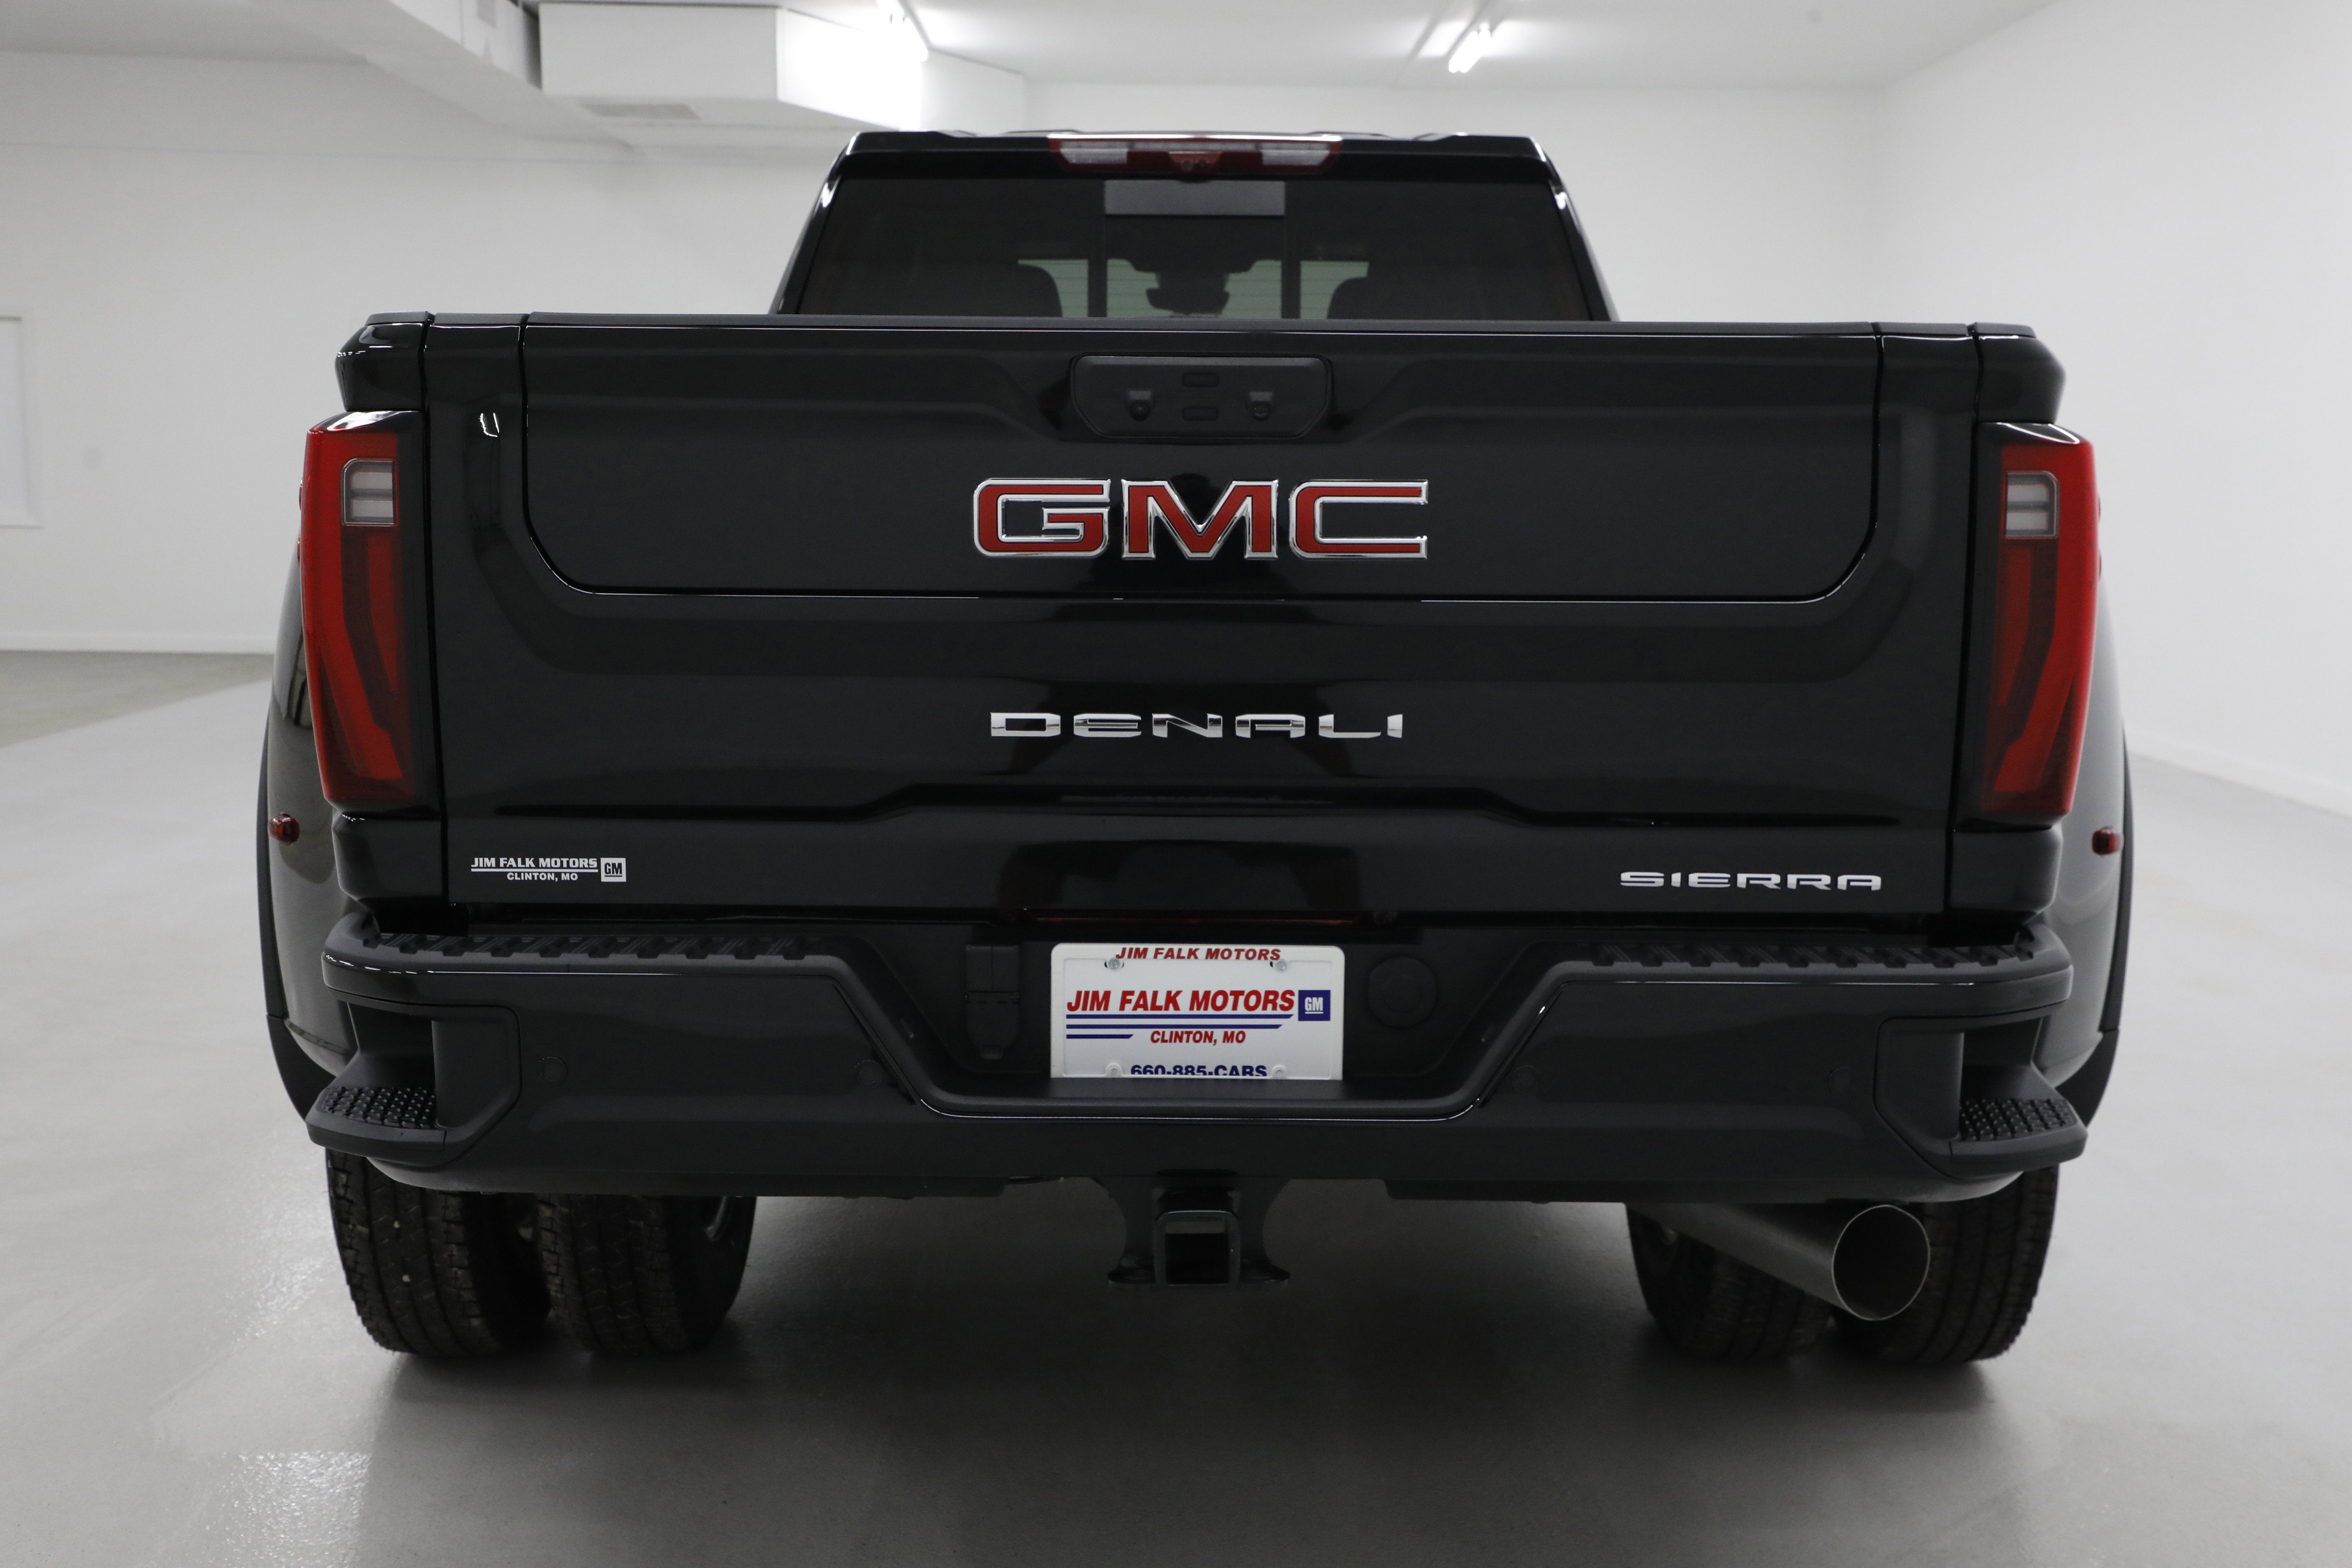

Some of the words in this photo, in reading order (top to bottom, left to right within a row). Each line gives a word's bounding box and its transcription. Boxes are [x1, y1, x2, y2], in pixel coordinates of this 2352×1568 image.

[973, 479, 1428, 560] GMC
[991, 712, 1403, 738] DENALI
[471, 858, 496, 867] JIM
[499, 858, 534, 867] FALK
[539, 858, 598, 868] MOTORS
[604, 862, 622, 875] GM
[506, 872, 558, 882] CLINTON,
[561, 873, 578, 881] MO
[1620, 871, 1882, 891] SIERRA
[1115, 947, 1147, 959] JIM
[1153, 948, 1199, 960] FALK
[1205, 948, 1281, 961] MOTORS
[1067, 990, 1111, 1011] JIM
[1118, 990, 1183, 1011] FALK
[1189, 990, 1295, 1012] MOTORS
[1304, 996, 1323, 1011] GM
[1150, 1030, 1217, 1046] CLINTON,
[1222, 1031, 1246, 1044] MO
